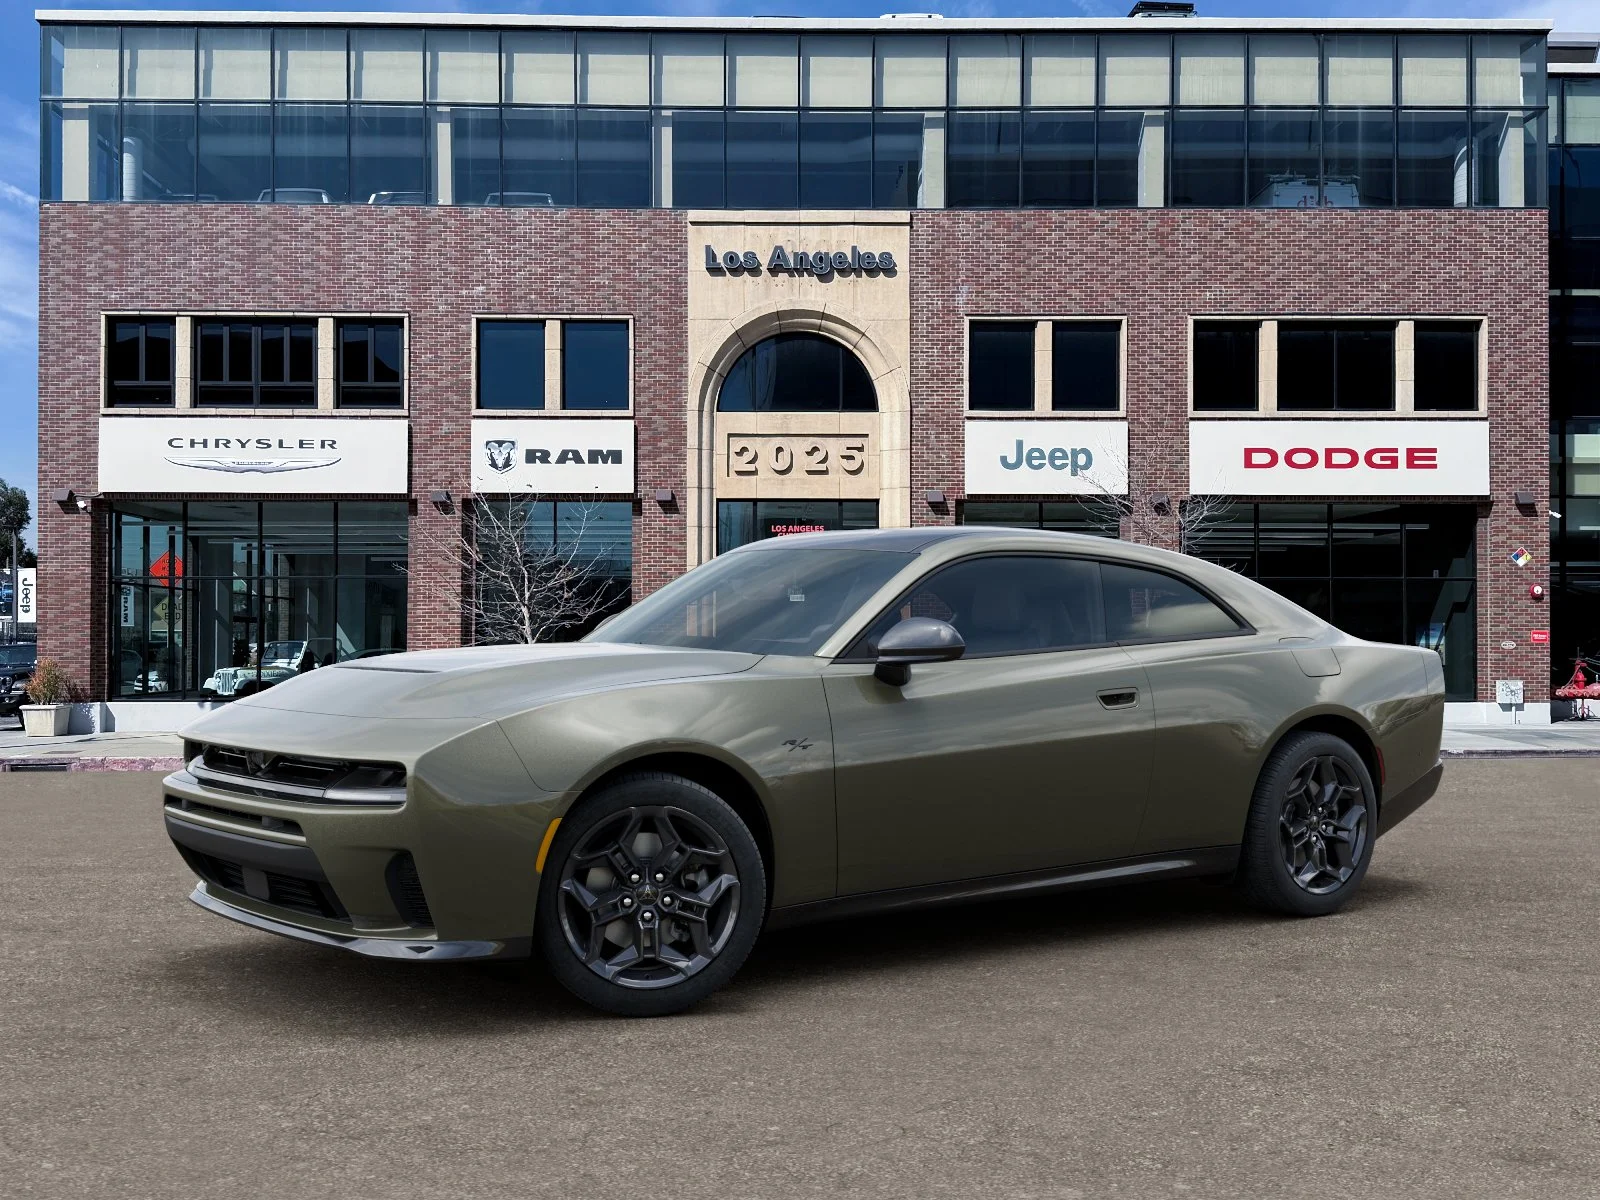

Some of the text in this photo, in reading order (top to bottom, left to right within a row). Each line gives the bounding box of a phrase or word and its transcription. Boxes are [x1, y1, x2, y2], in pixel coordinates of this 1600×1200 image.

[704, 244, 895, 274] Los Angeles
[167, 437, 338, 450] CHRYSLER
[525, 448, 623, 464] RAM
[733, 440, 865, 475] 2025
[1000, 439, 1093, 476] Jeep
[1243, 447, 1438, 469] DODGE
[788, 525, 825, 533] ANGELES
[20, 577, 34, 614] Jeep
